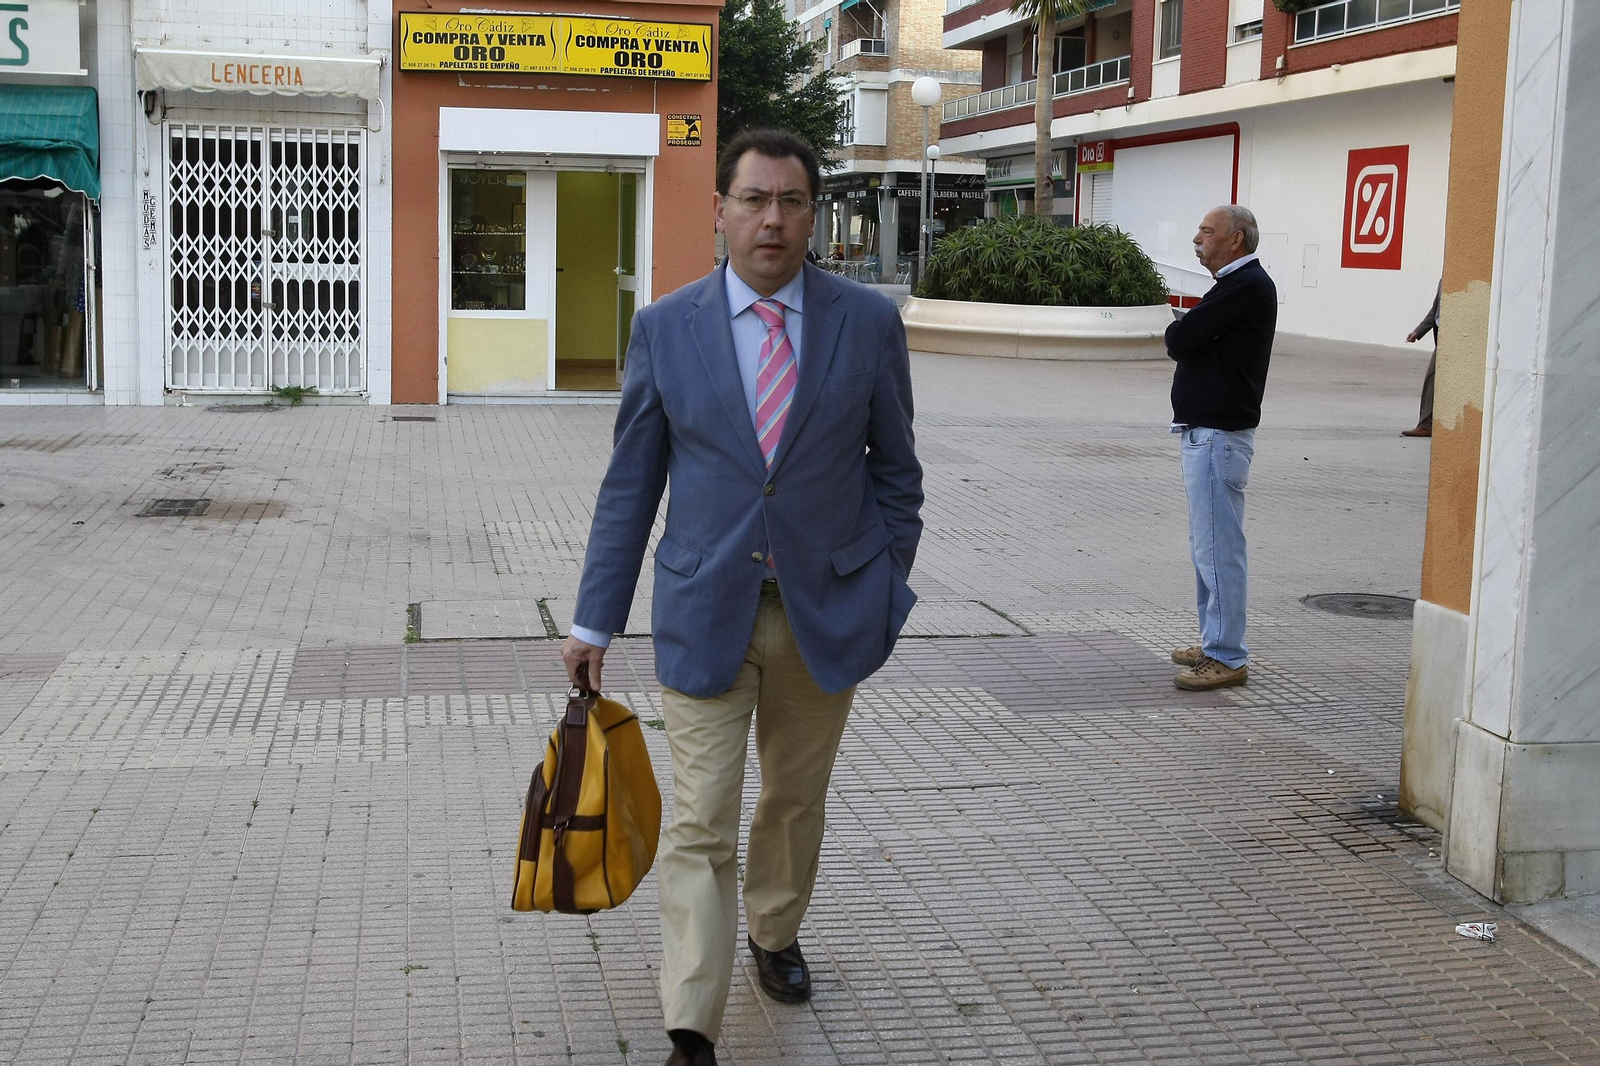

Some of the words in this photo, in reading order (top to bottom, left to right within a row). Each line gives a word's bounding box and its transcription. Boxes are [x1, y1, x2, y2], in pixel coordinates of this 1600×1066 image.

[445, 17, 472, 32] Oro
[474, 17, 515, 33] Cádiz
[605, 22, 631, 36] Oro
[633, 22, 670, 38] Cádiz
[412, 31, 480, 45] COMPRA
[485, 33, 494, 45] Y
[497, 34, 546, 46] VENTA
[575, 35, 640, 51] COMPRA
[641, 38, 651, 51] Y
[655, 39, 699, 53] VENTA
[454, 45, 506, 62] ORO
[614, 51, 663, 69] ORO
[439, 61, 478, 69] PAPELETAS
[490, 61, 520, 70] EMPEÑO
[600, 67, 637, 76] PAPELETAS
[648, 68, 676, 77] EMPEÑO
[211, 62, 305, 87] LENCERIA
[461, 172, 507, 186] JOYER
[897, 189, 921, 197] CAFETER
[934, 190, 959, 198] ELADERIA
[961, 191, 985, 199] PASTELE
